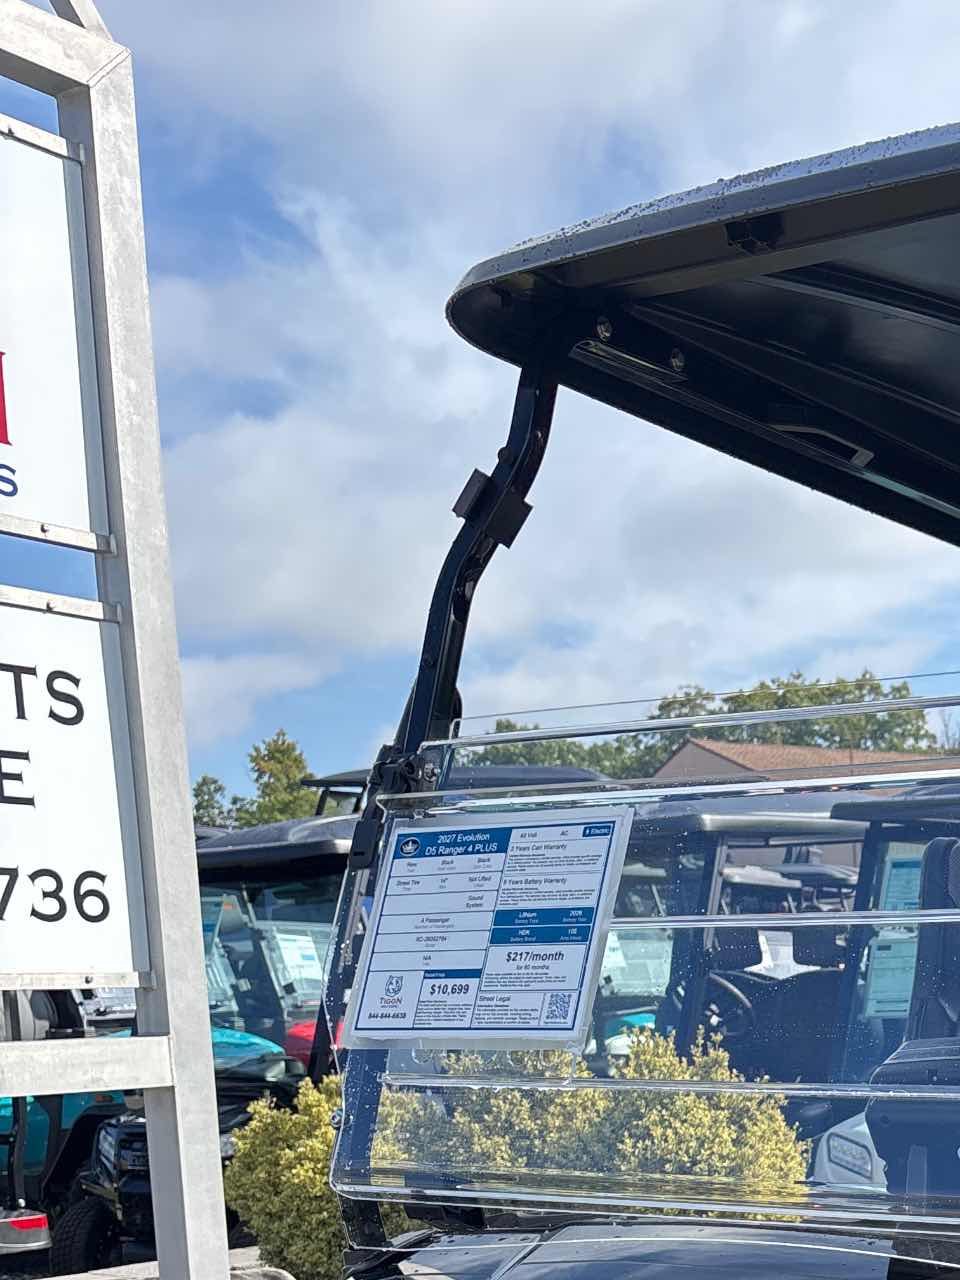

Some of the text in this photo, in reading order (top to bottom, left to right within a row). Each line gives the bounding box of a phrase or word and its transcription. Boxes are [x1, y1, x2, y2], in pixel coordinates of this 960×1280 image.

[0, 662, 84, 726] TS
[0, 749, 36, 808] E
[438, 833, 490, 844] 2027 Evolution
[425, 842, 498, 856] D5 Ranger 4 PLUS
[0, 865, 110, 923] 736
[506, 951, 564, 963] $217/month
[430, 983, 470, 996] $10,699
[380, 996, 403, 1005] TIGON
